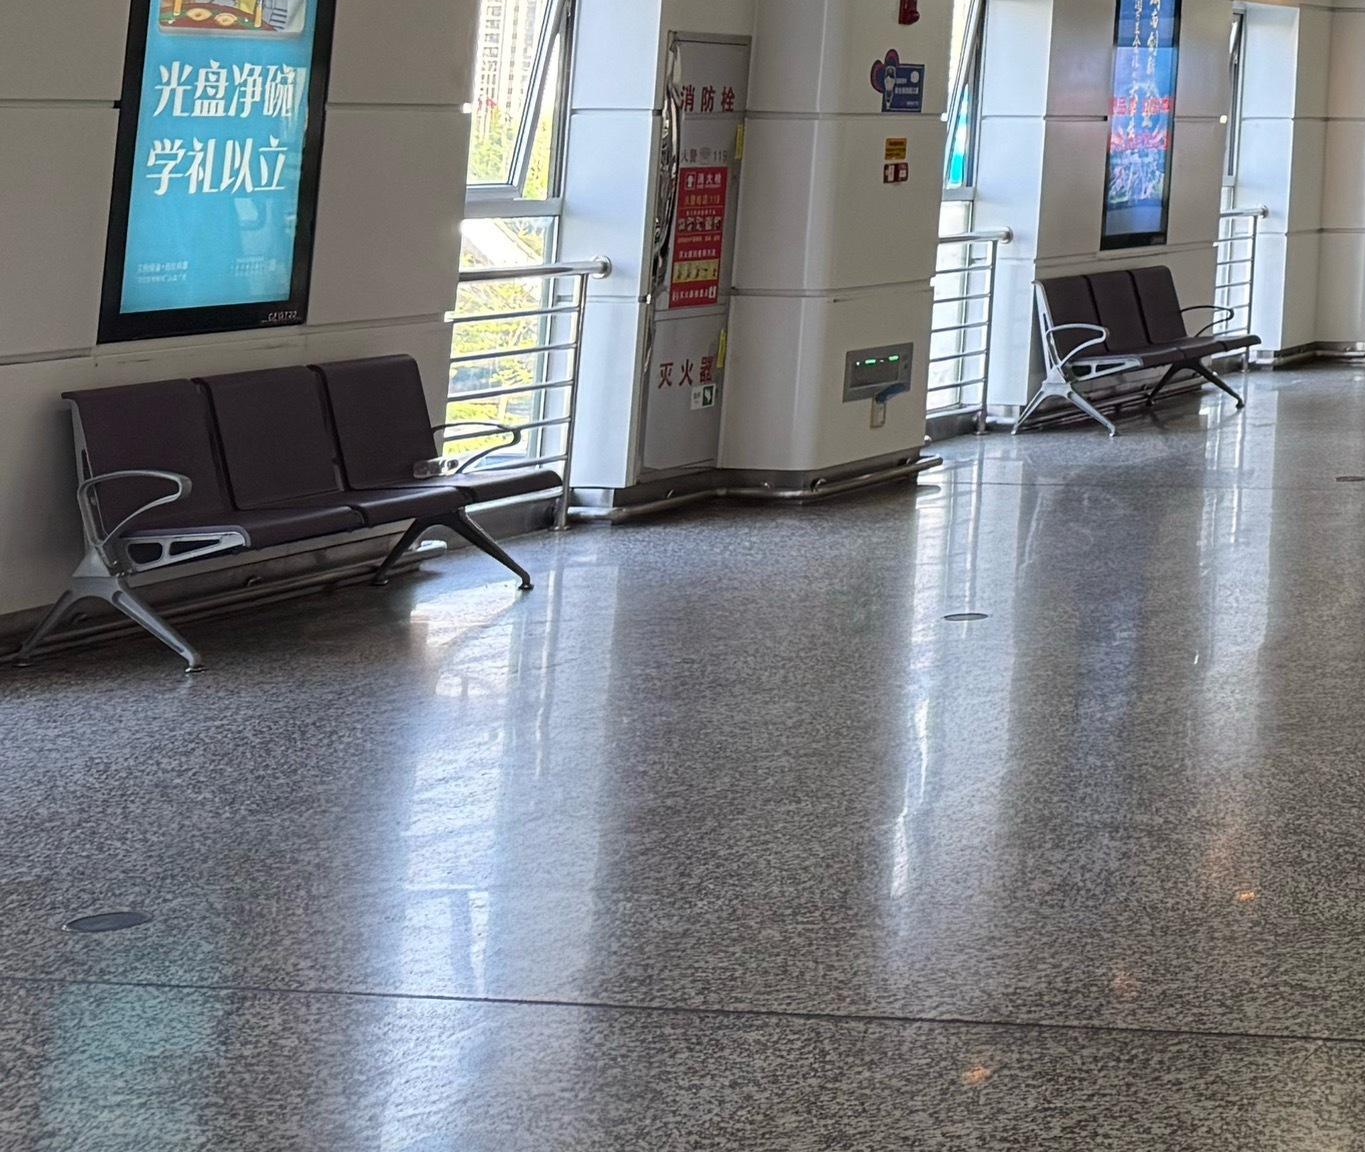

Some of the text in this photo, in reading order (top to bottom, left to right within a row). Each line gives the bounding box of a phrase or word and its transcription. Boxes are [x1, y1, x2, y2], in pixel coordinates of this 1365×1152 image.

[154, 59, 297, 119] 光盘净碗
[679, 85, 736, 113] 消防栓
[145, 136, 288, 197] 学礼以立
[657, 356, 715, 389] 灭火器
